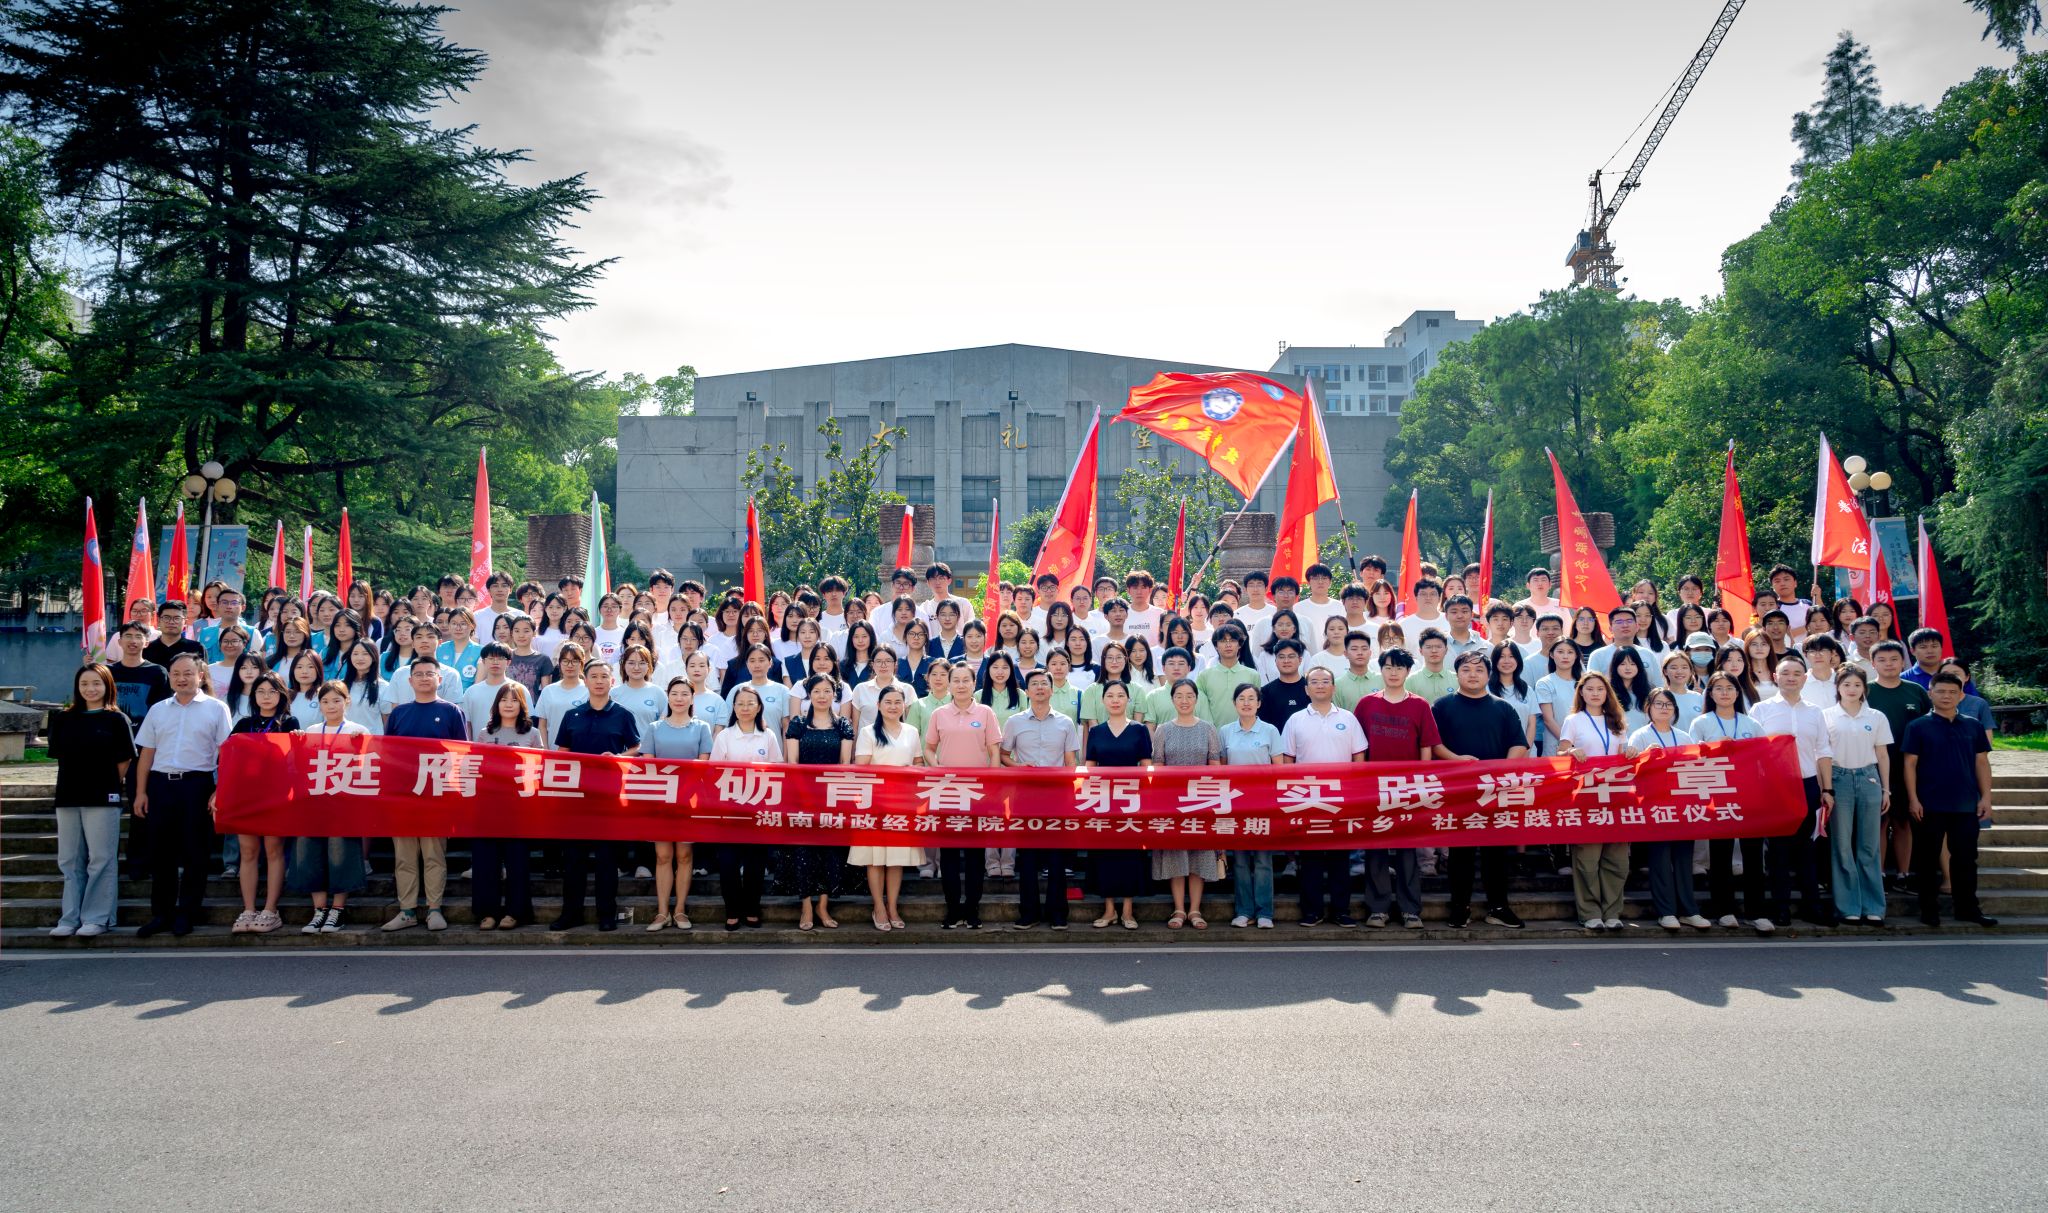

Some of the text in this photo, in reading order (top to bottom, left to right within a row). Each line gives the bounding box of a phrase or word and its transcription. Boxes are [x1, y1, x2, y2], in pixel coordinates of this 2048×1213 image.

[308, 750, 1737, 813] 挺膺担当砺青春 躬身实践谱华章
